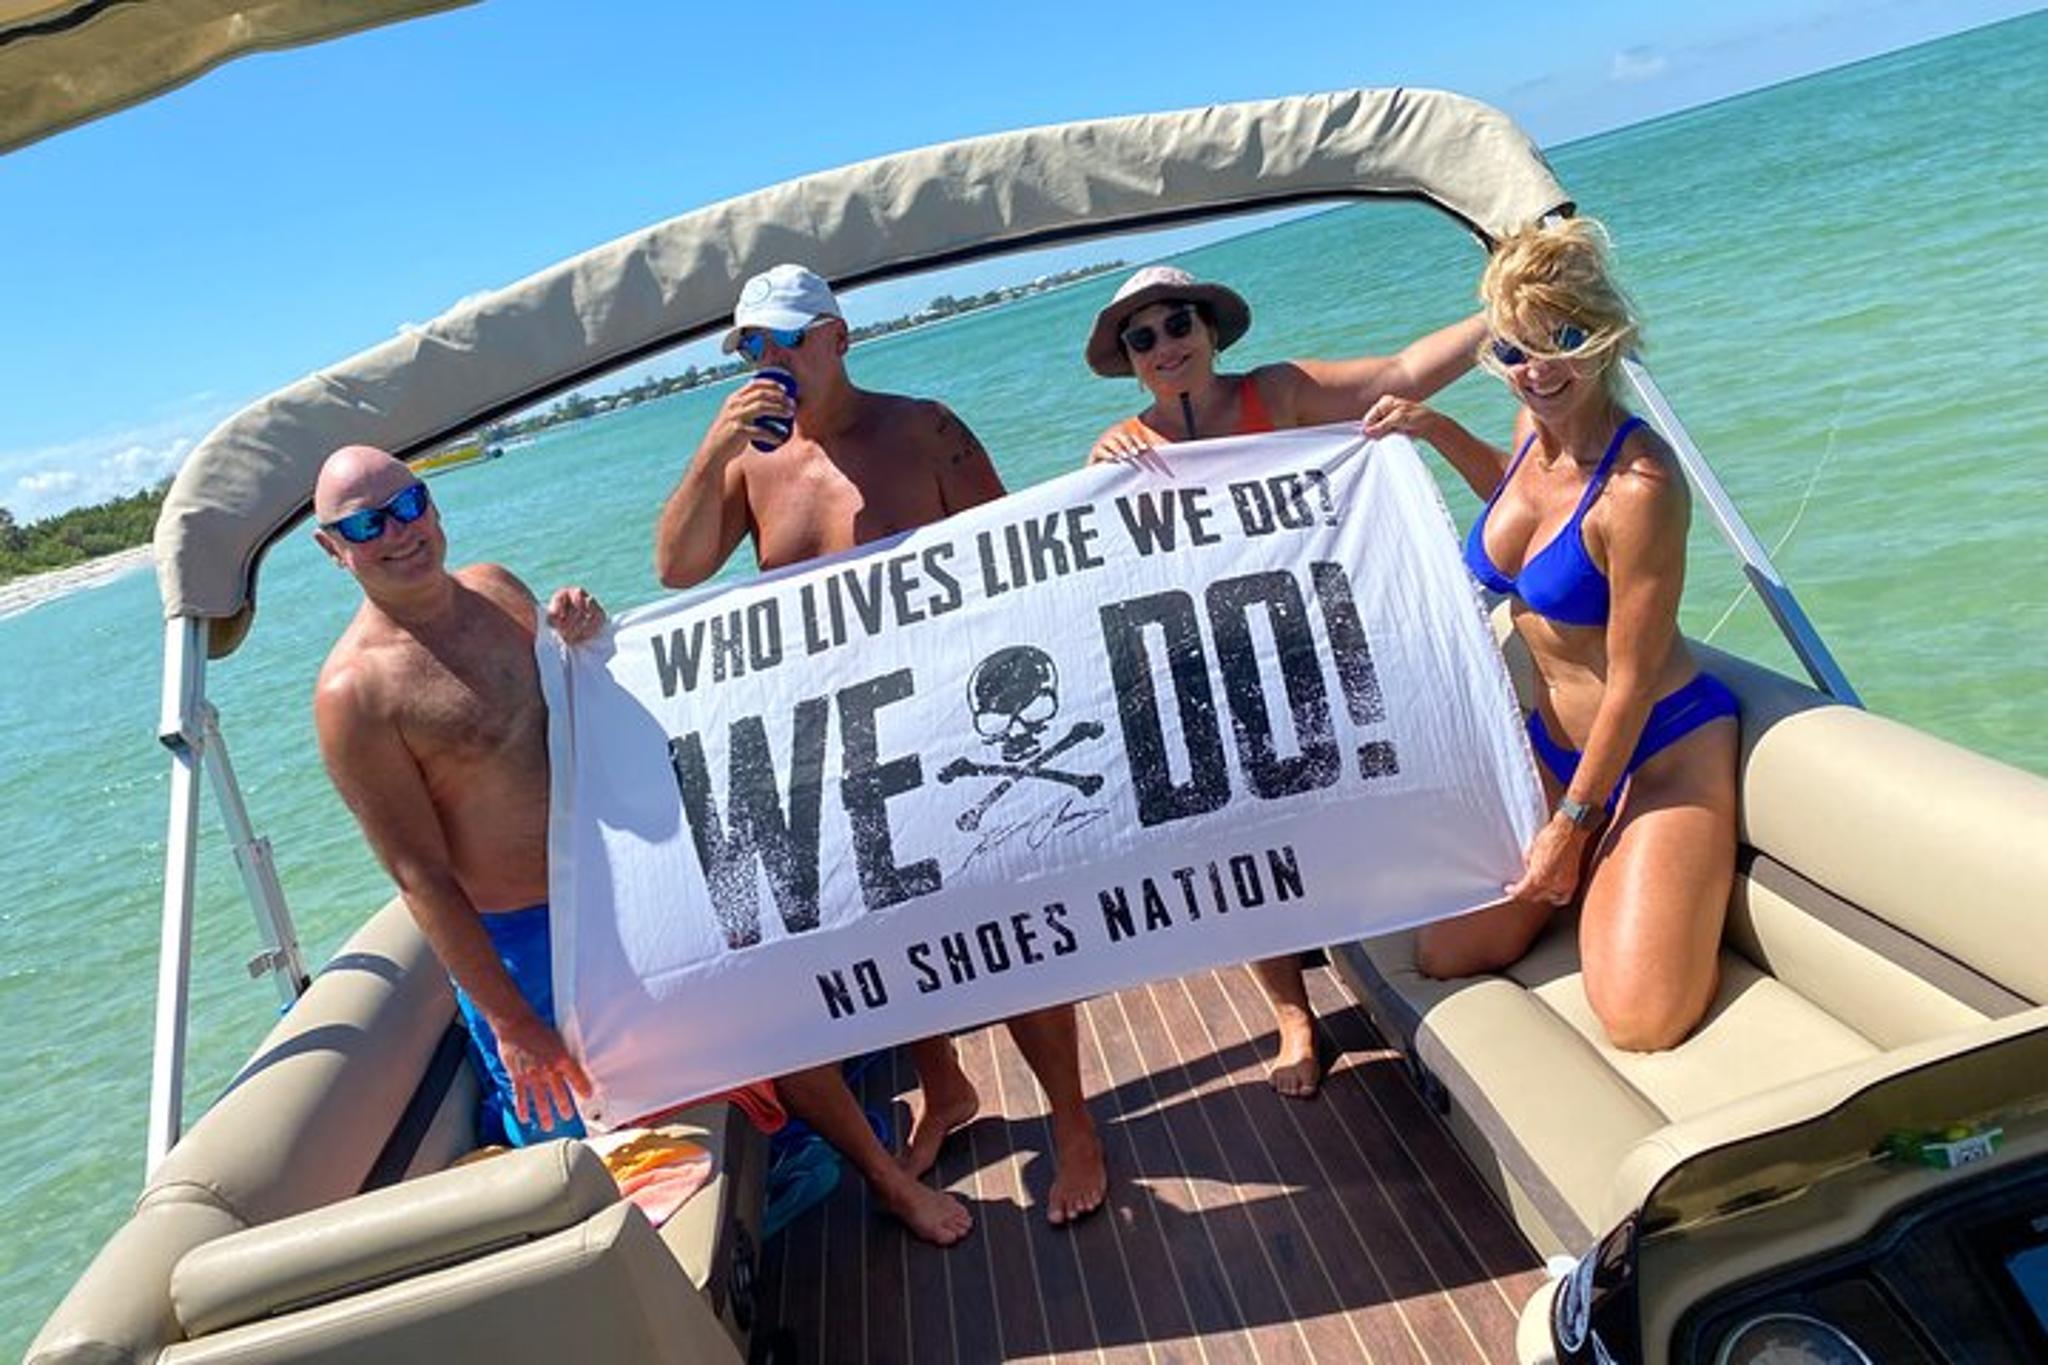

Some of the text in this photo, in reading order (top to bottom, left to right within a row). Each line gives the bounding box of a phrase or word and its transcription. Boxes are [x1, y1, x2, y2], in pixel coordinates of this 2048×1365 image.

[651, 597, 784, 697] WHO
[803, 541, 962, 655] LIVES
[978, 504, 1105, 597] LIKE
[1116, 487, 1222, 557] WE
[669, 561, 1400, 949] WE DO!
[816, 845, 1305, 1019] NO SHOES NATION
